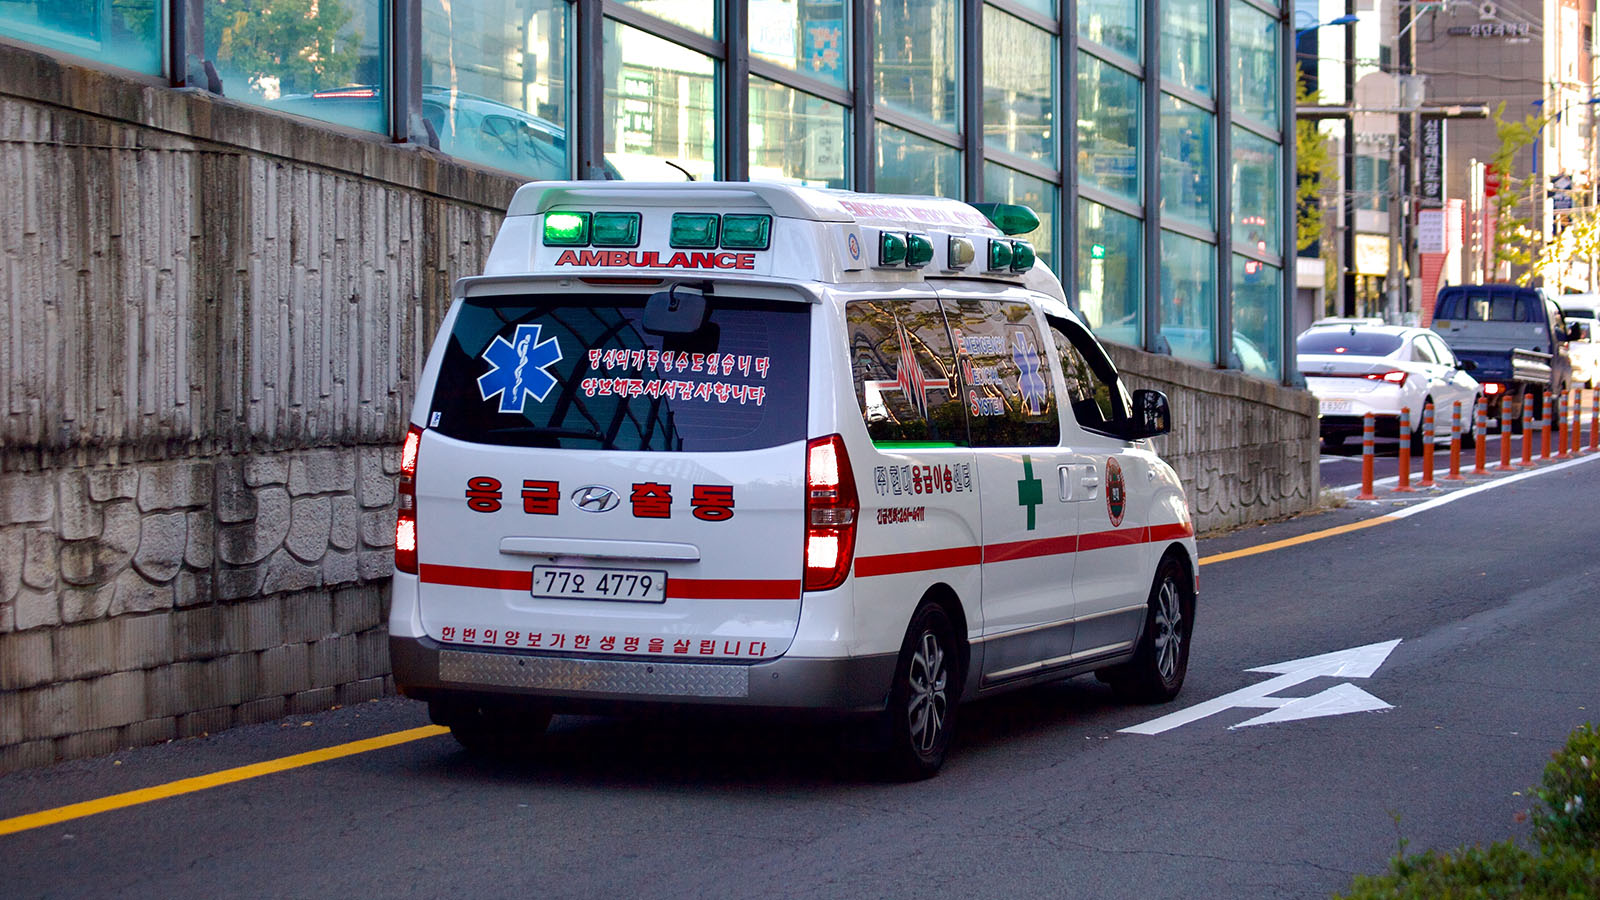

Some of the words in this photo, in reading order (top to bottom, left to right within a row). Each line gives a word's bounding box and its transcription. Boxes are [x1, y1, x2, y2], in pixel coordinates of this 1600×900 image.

[555, 250, 755, 269] AMBULANCE
[953, 328, 1006, 356] EMERGENCY
[962, 359, 1003, 386] MEDICAL
[969, 389, 1005, 417] SYSTEM
[544, 571, 586, 594] 77오
[596, 573, 654, 597] 4779
